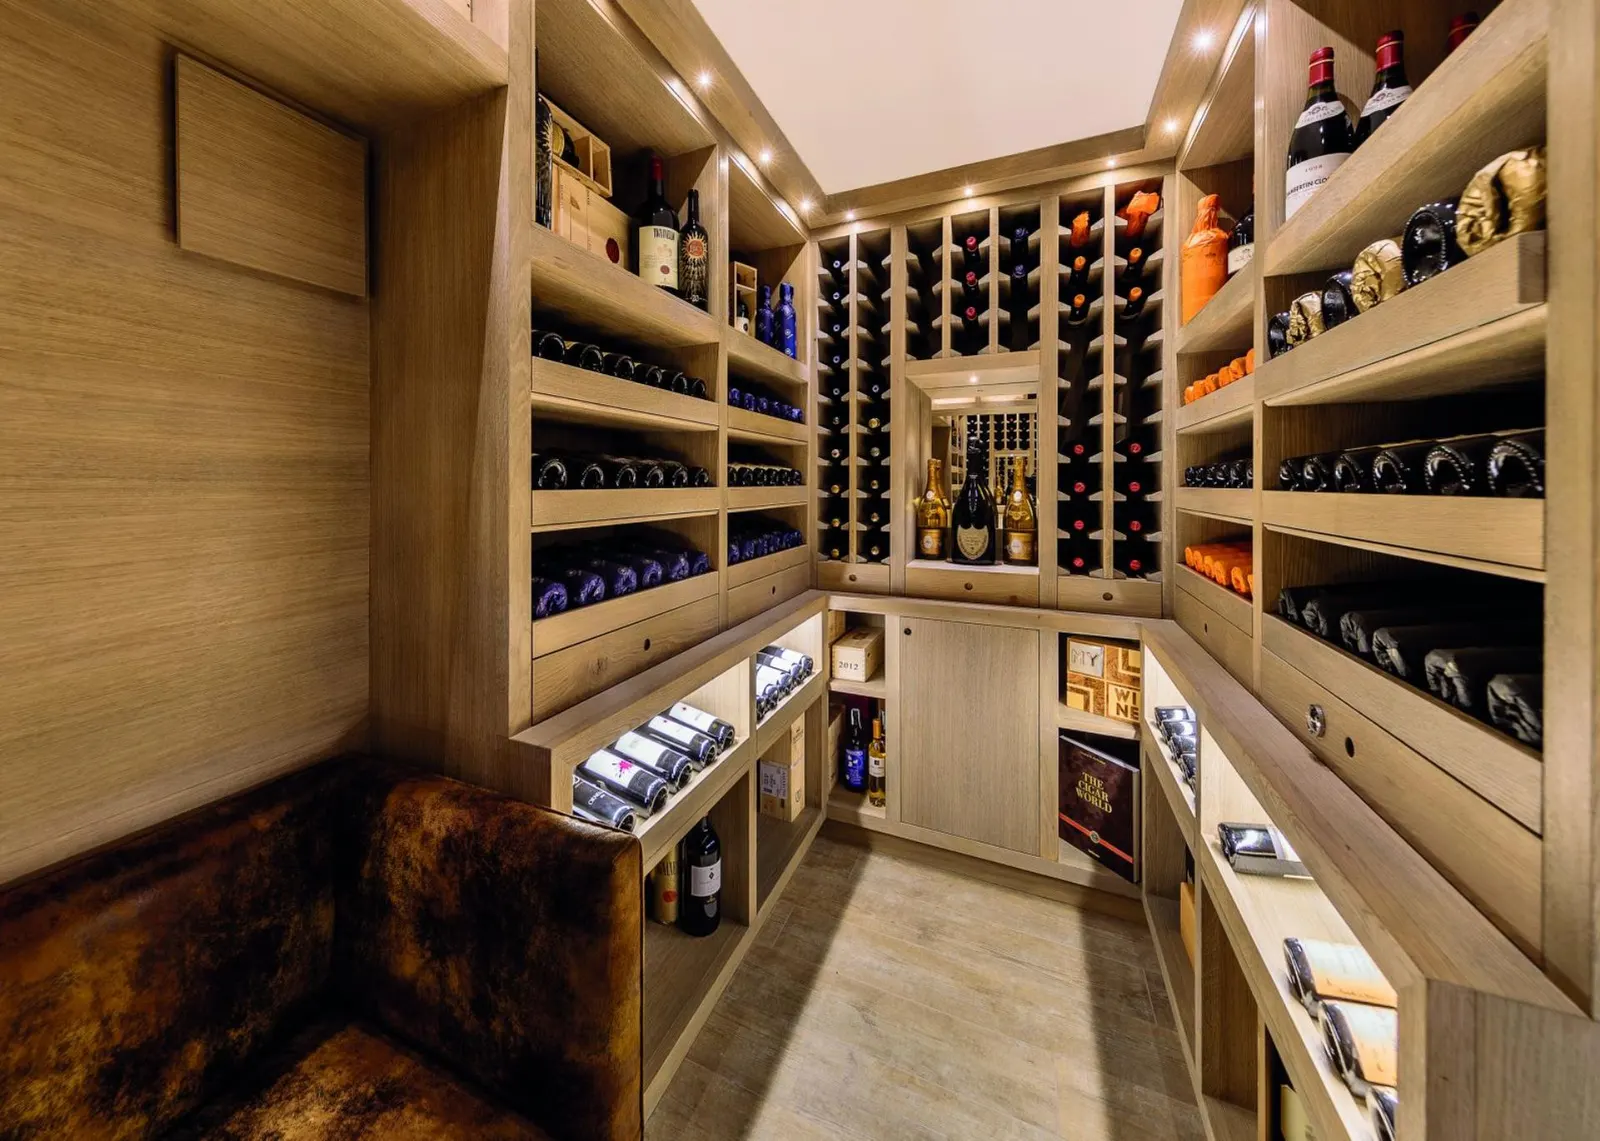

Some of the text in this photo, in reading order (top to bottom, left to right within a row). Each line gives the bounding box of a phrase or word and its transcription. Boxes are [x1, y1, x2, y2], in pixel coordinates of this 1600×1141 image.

[1314, 176, 1330, 185] CLO
[839, 661, 859, 671] 2012
[1072, 648, 1099, 667] MY
[1114, 688, 1137, 706] WI
[1116, 702, 1139, 720] NE
[1082, 772, 1104, 790] THE
[1075, 786, 1112, 813] WORLD
[1078, 780, 1110, 802] CIGAR
